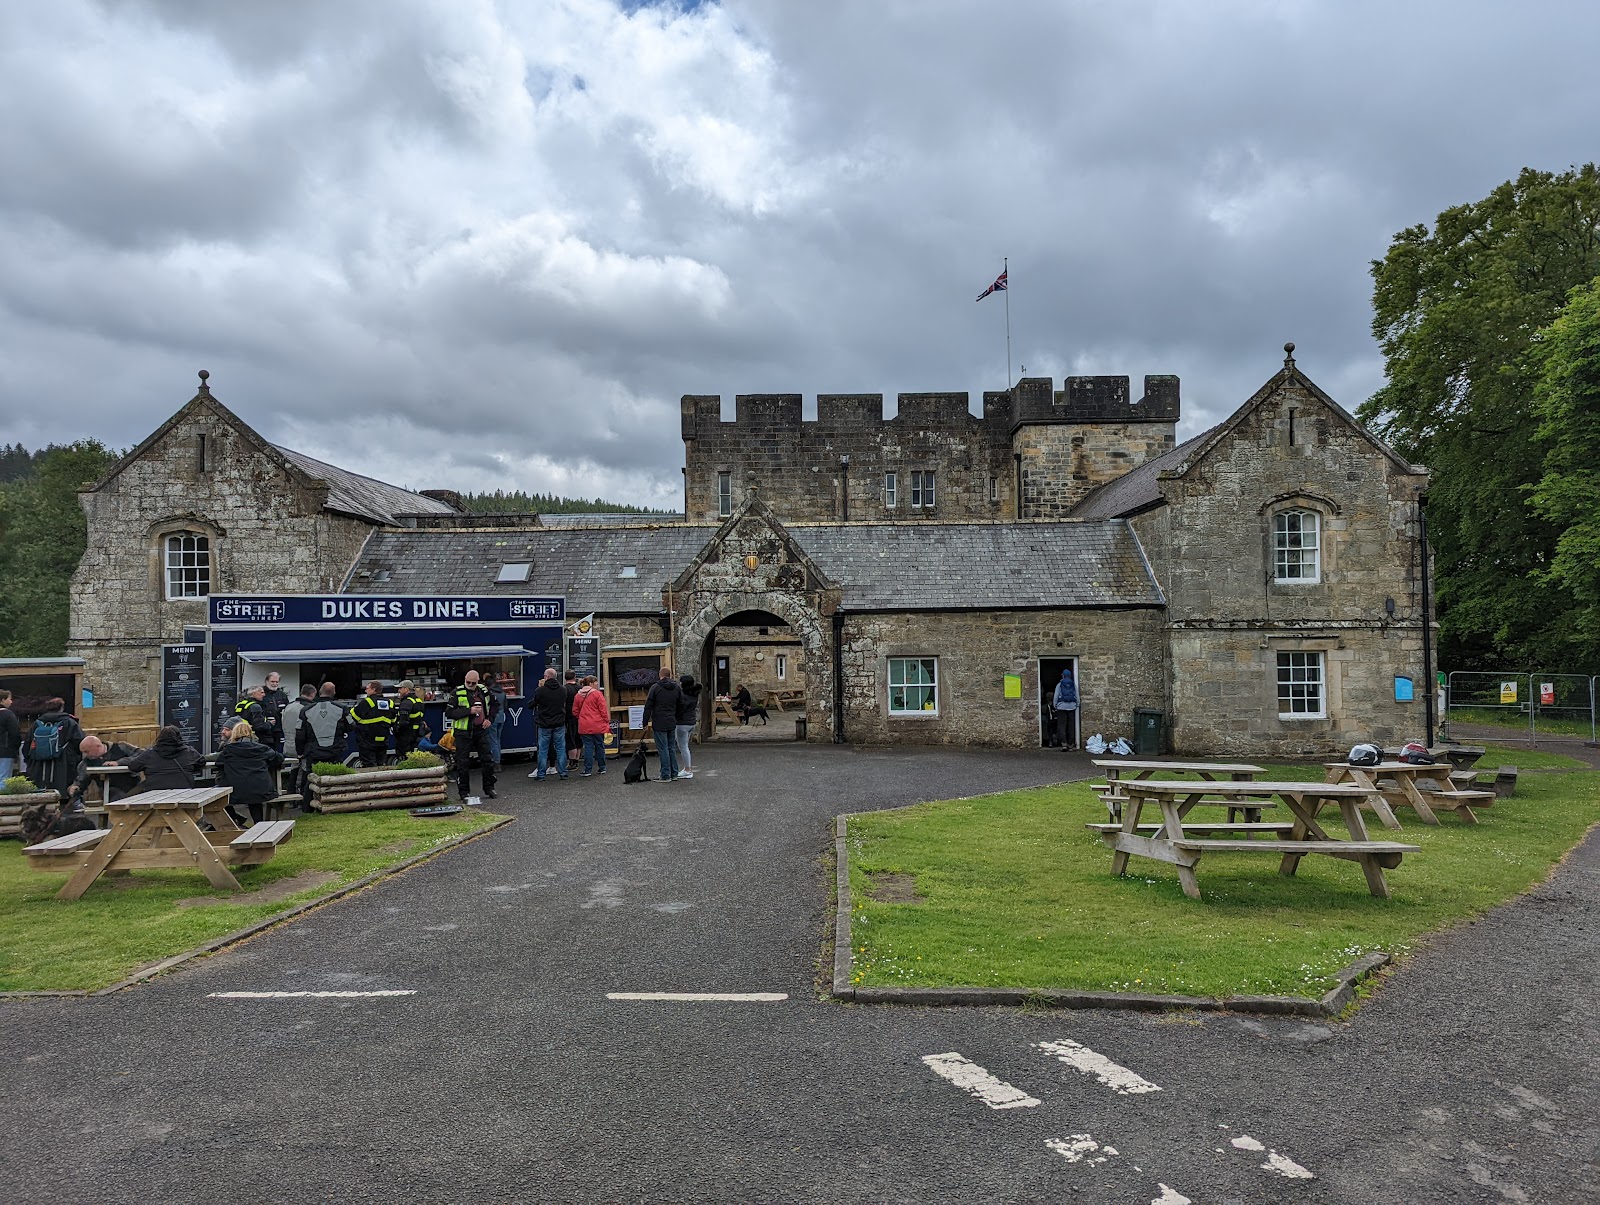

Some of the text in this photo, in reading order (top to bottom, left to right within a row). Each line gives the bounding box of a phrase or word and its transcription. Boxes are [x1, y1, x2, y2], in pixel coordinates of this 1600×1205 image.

[222, 605, 280, 616] STREET
[322, 601, 479, 618] DUKES DINER
[513, 605, 556, 614] STREET
